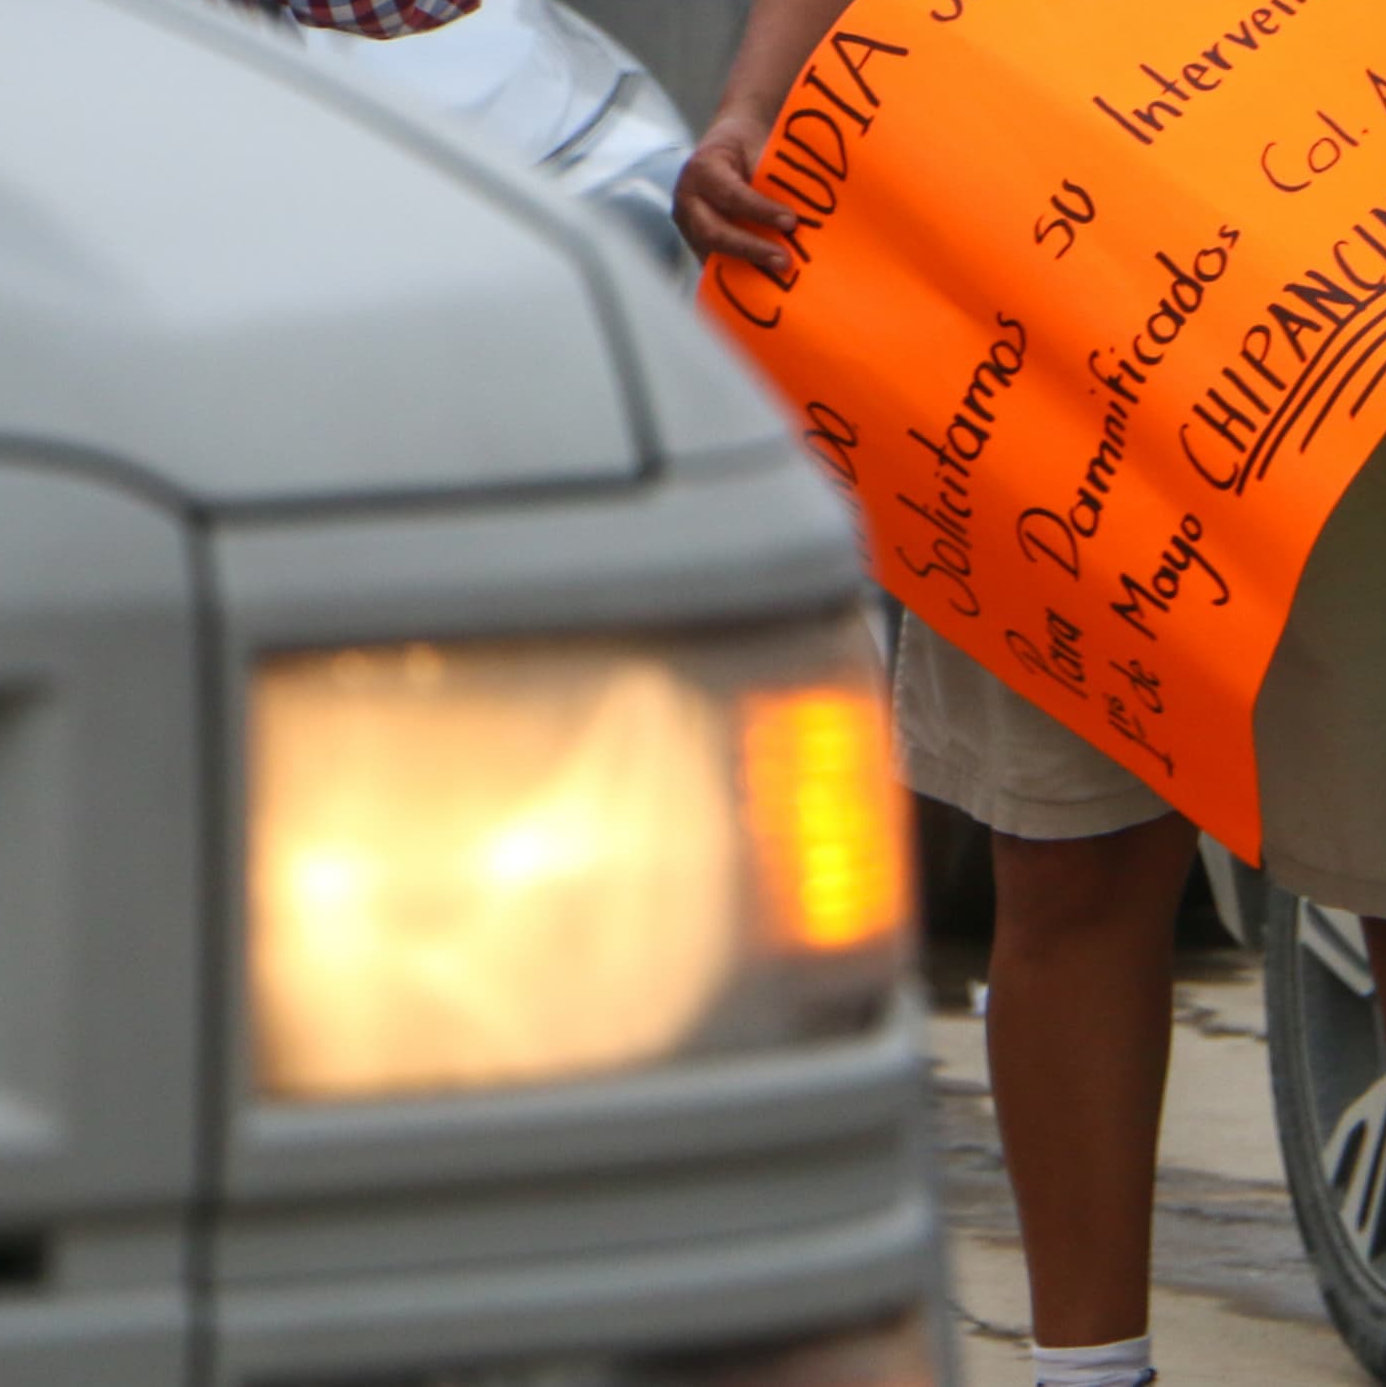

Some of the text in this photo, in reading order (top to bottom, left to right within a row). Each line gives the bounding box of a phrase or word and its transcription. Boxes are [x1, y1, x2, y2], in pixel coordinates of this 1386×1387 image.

[715, 29, 910, 330] CLAUDIA
[895, 311, 1028, 617] Solicitamos
[1016, 223, 1241, 582] Damnificados
[1260, 109, 1371, 193] Col.
[1109, 513, 1231, 642] Mayo
